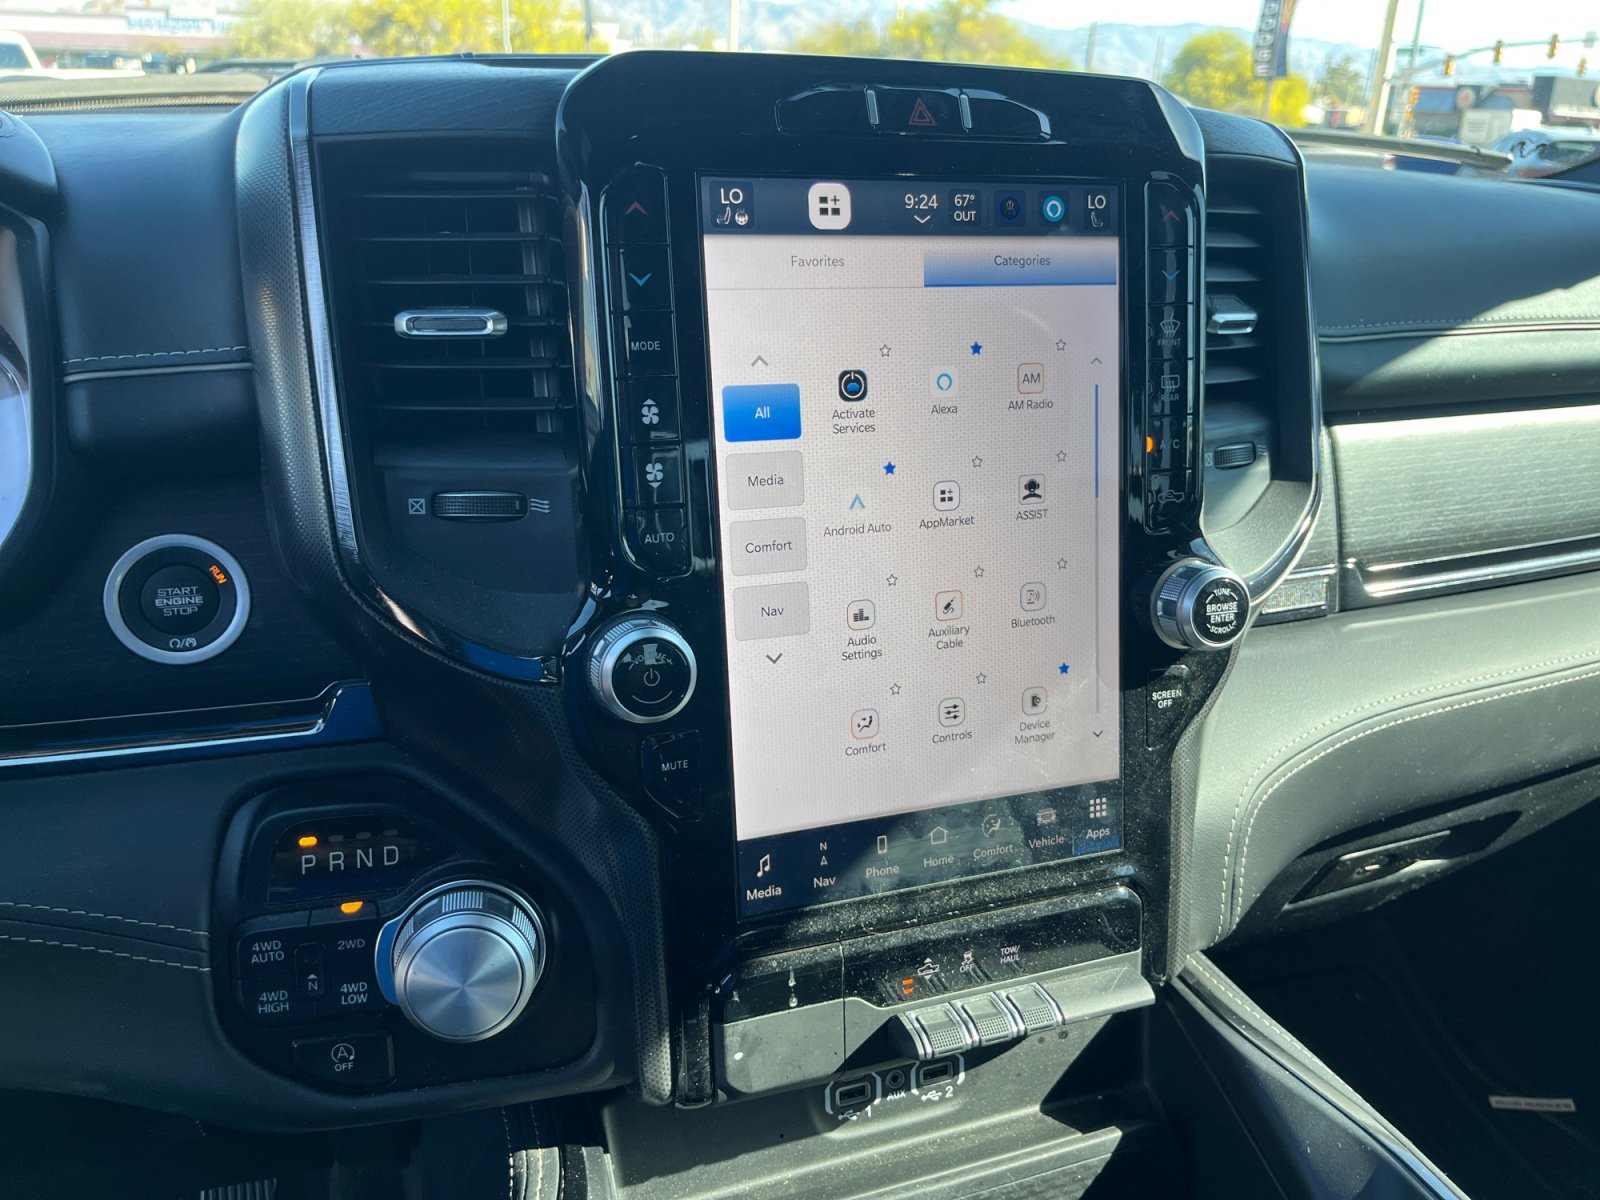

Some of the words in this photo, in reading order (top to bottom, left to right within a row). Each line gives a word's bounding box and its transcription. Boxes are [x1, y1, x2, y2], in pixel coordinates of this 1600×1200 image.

[720, 188, 744, 204] LO
[1087, 195, 1106, 209] LO
[904, 194, 938, 211] 9:24
[954, 210, 976, 222] OUT
[790, 256, 845, 268] Favorites
[994, 254, 1051, 269] Categories
[630, 340, 661, 351] MODE
[1022, 373, 1041, 384] AM
[931, 403, 958, 415] Alexa
[1008, 400, 1024, 410] AM
[1026, 399, 1054, 410] Radio
[754, 407, 770, 419] All
[832, 408, 875, 420] Activate
[832, 422, 876, 434] Services
[747, 475, 784, 487] Media
[1016, 509, 1048, 520] ASSIST
[919, 514, 975, 530] AppMarket
[823, 524, 866, 537] Android
[867, 522, 892, 533] Auto
[644, 531, 675, 544] AUTO
[745, 540, 793, 553] Comfort
[209, 565, 227, 584] RUN
[157, 586, 199, 597] START
[1214, 588, 1231, 596] TUNE
[155, 596, 203, 606] ENGINE
[1206, 602, 1238, 612] BROWSE
[163, 607, 199, 616] STOP
[761, 606, 784, 617] Nav
[1011, 614, 1055, 629] Bluetooth
[1211, 613, 1235, 623] ENTER
[928, 624, 970, 639] Auxiliary
[1210, 625, 1235, 634] SCROLL
[847, 635, 877, 647] Audio
[936, 638, 964, 649] Cable
[841, 648, 883, 661] Settings
[1152, 690, 1182, 700] SCREEN
[1158, 699, 1173, 709] OFF
[1019, 718, 1050, 731] Device
[932, 729, 973, 744] Controls
[1014, 730, 1056, 746] Manager
[845, 742, 886, 757] Comfort
[661, 758, 688, 771] MUTE
[1086, 825, 1110, 840] Apps
[819, 842, 827, 850] N
[1029, 833, 1065, 848] Vehicle
[973, 843, 1014, 859] Comfort
[301, 854, 316, 874] P
[329, 852, 345, 871] R
[356, 849, 373, 868] N
[383, 845, 399, 865] D
[923, 854, 955, 868] Home
[865, 863, 900, 878] Phone
[813, 875, 836, 888] Nav
[747, 884, 782, 901] Media
[251, 941, 281, 952] 4WD
[337, 939, 365, 950] 2WD
[251, 951, 285, 963] AUTO
[1000, 954, 1020, 964] HAUL
[960, 964, 973, 973] OFF
[340, 982, 368, 993] 4WD
[259, 991, 288, 1001] 4WD
[341, 993, 368, 1005] LOW
[259, 1002, 289, 1014] HIGH
[334, 1062, 353, 1071] OFF
[887, 1090, 906, 1101] AUX
[945, 1086, 954, 1098] 2
